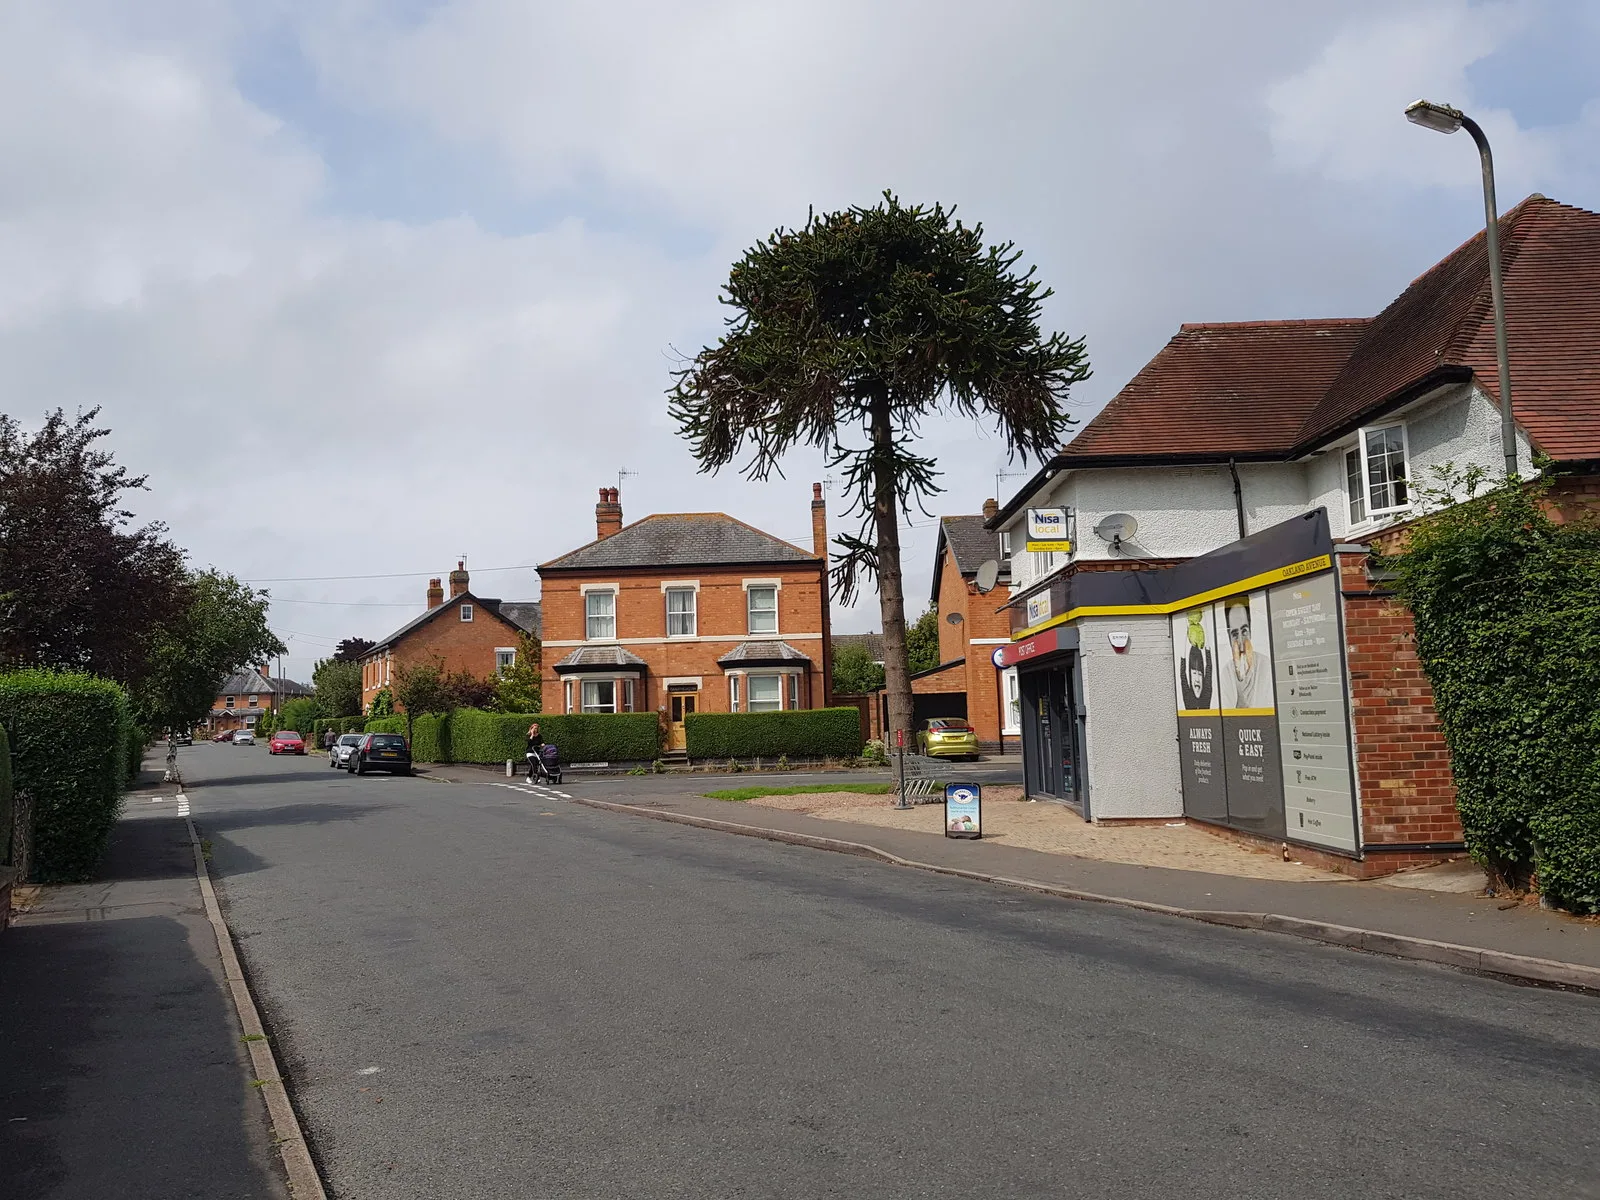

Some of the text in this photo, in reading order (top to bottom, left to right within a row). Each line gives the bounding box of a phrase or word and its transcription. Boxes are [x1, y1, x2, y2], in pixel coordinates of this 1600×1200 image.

[1035, 513, 1060, 524] Nisa
[1035, 525, 1060, 534] local
[1282, 558, 1326, 577] OAKLAND AVENUE
[1029, 600, 1039, 619] Nisa
[1286, 609, 1297, 617] OPEN
[1298, 605, 1312, 615] EVERY
[1026, 642, 1036, 654] OFFICE
[1190, 728, 1212, 740] ALWAYS
[1238, 729, 1262, 743] QUICK
[1192, 742, 1211, 753] FRESH
[1239, 744, 1264, 757] & EASY
